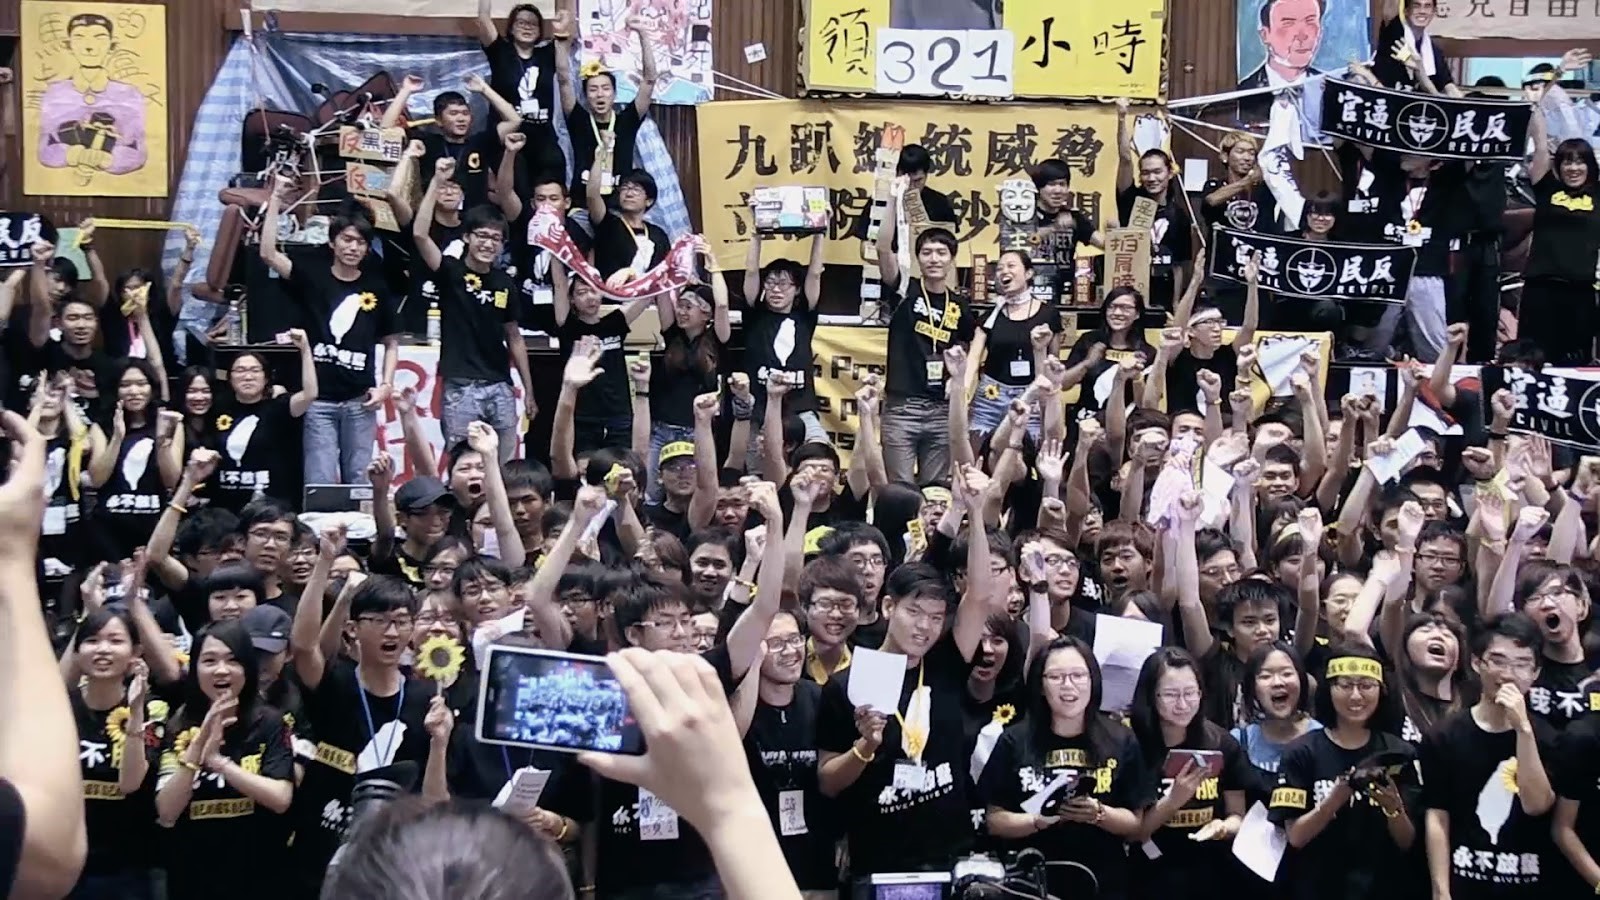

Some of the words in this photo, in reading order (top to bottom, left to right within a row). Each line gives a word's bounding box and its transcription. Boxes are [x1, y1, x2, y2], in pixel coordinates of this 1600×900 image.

[883, 36, 1008, 92] 321
[1021, 17, 1147, 75] 小時
[1338, 90, 1392, 131] 官逼
[1451, 110, 1512, 142] 民反
[1448, 142, 1512, 153] REVOLT
[1338, 254, 1397, 285] 民反
[1336, 284, 1397, 295] REVOLT
[1516, 412, 1573, 437] CIVIL
[1453, 845, 1540, 875] 永不放棄
